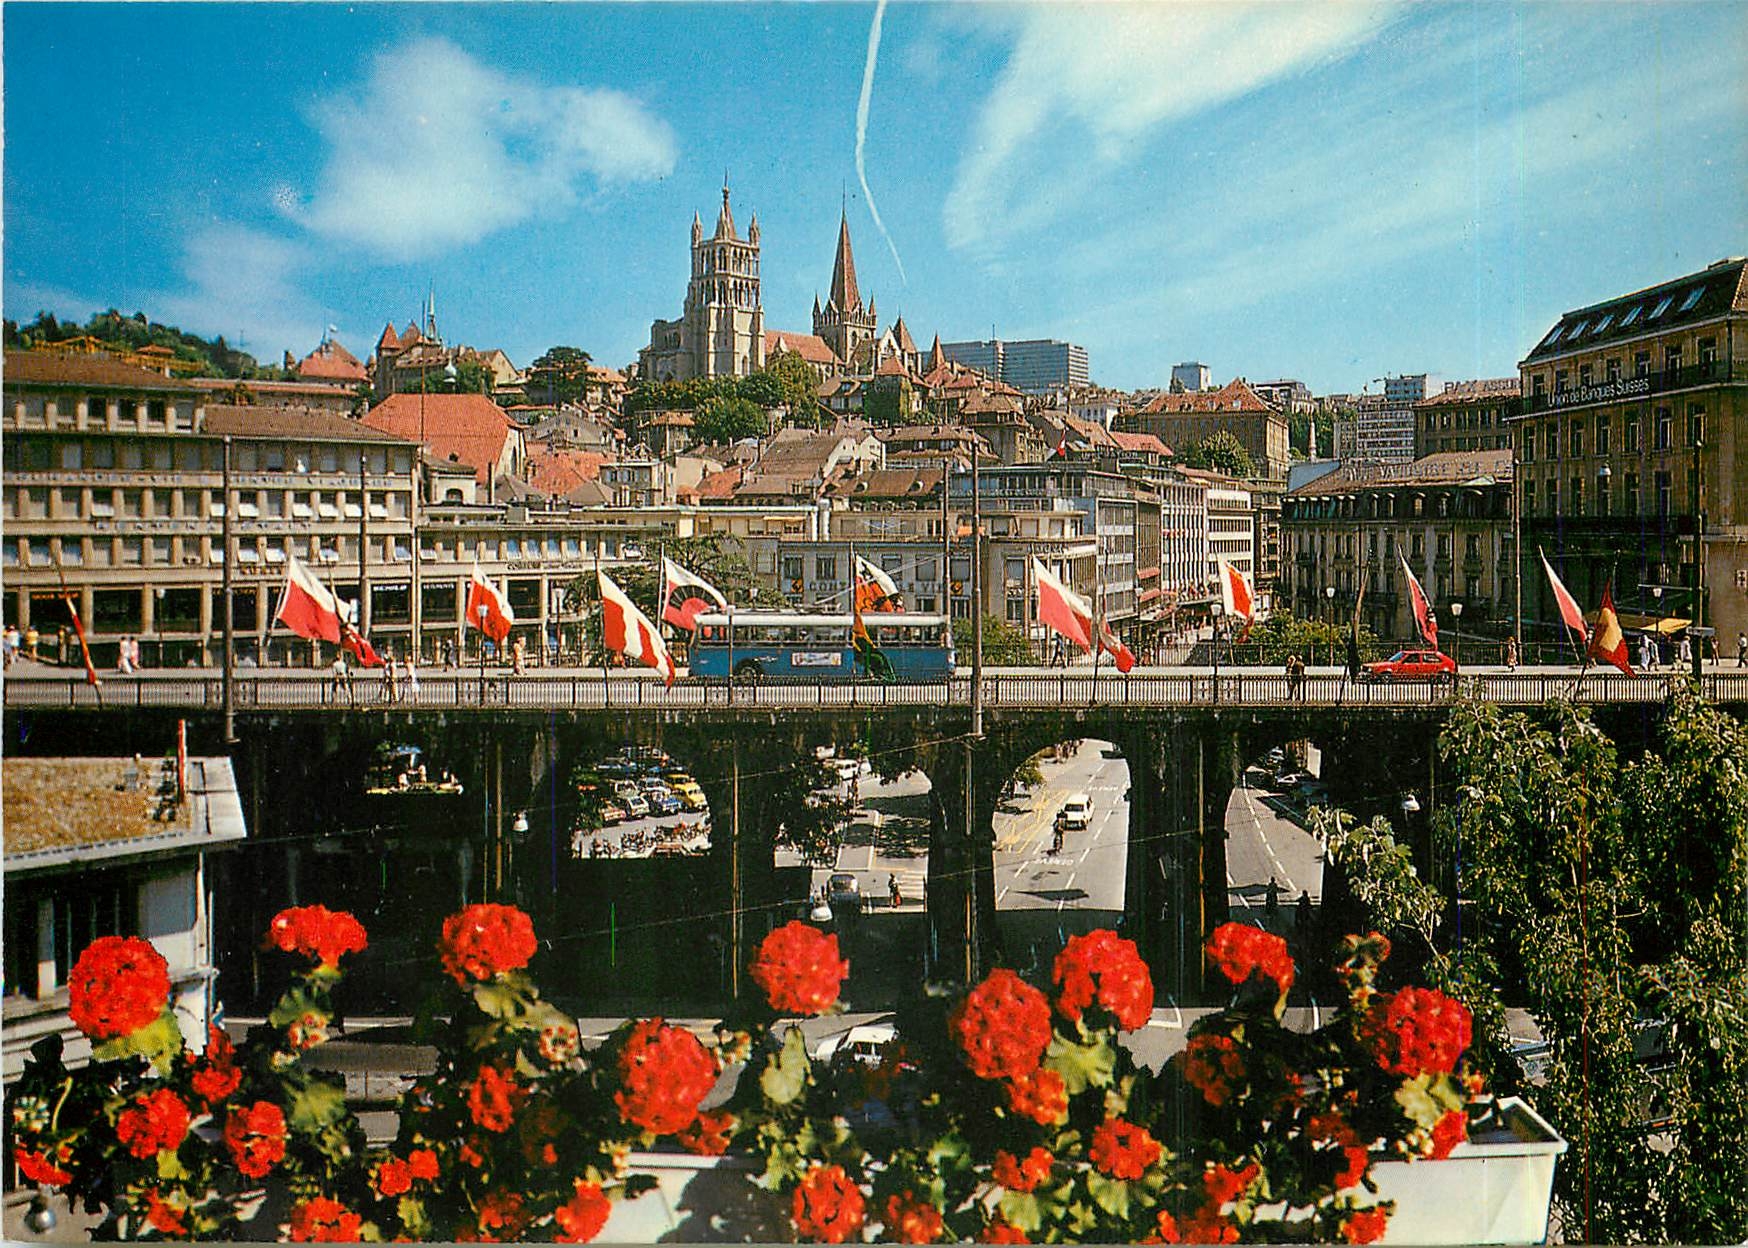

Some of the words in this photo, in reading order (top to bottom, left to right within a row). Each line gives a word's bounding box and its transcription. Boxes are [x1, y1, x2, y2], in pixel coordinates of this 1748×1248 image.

[1547, 391, 1569, 407] Union
[1570, 388, 1580, 403] de
[1581, 384, 1615, 401] Banques
[1616, 378, 1649, 395] Suisses
